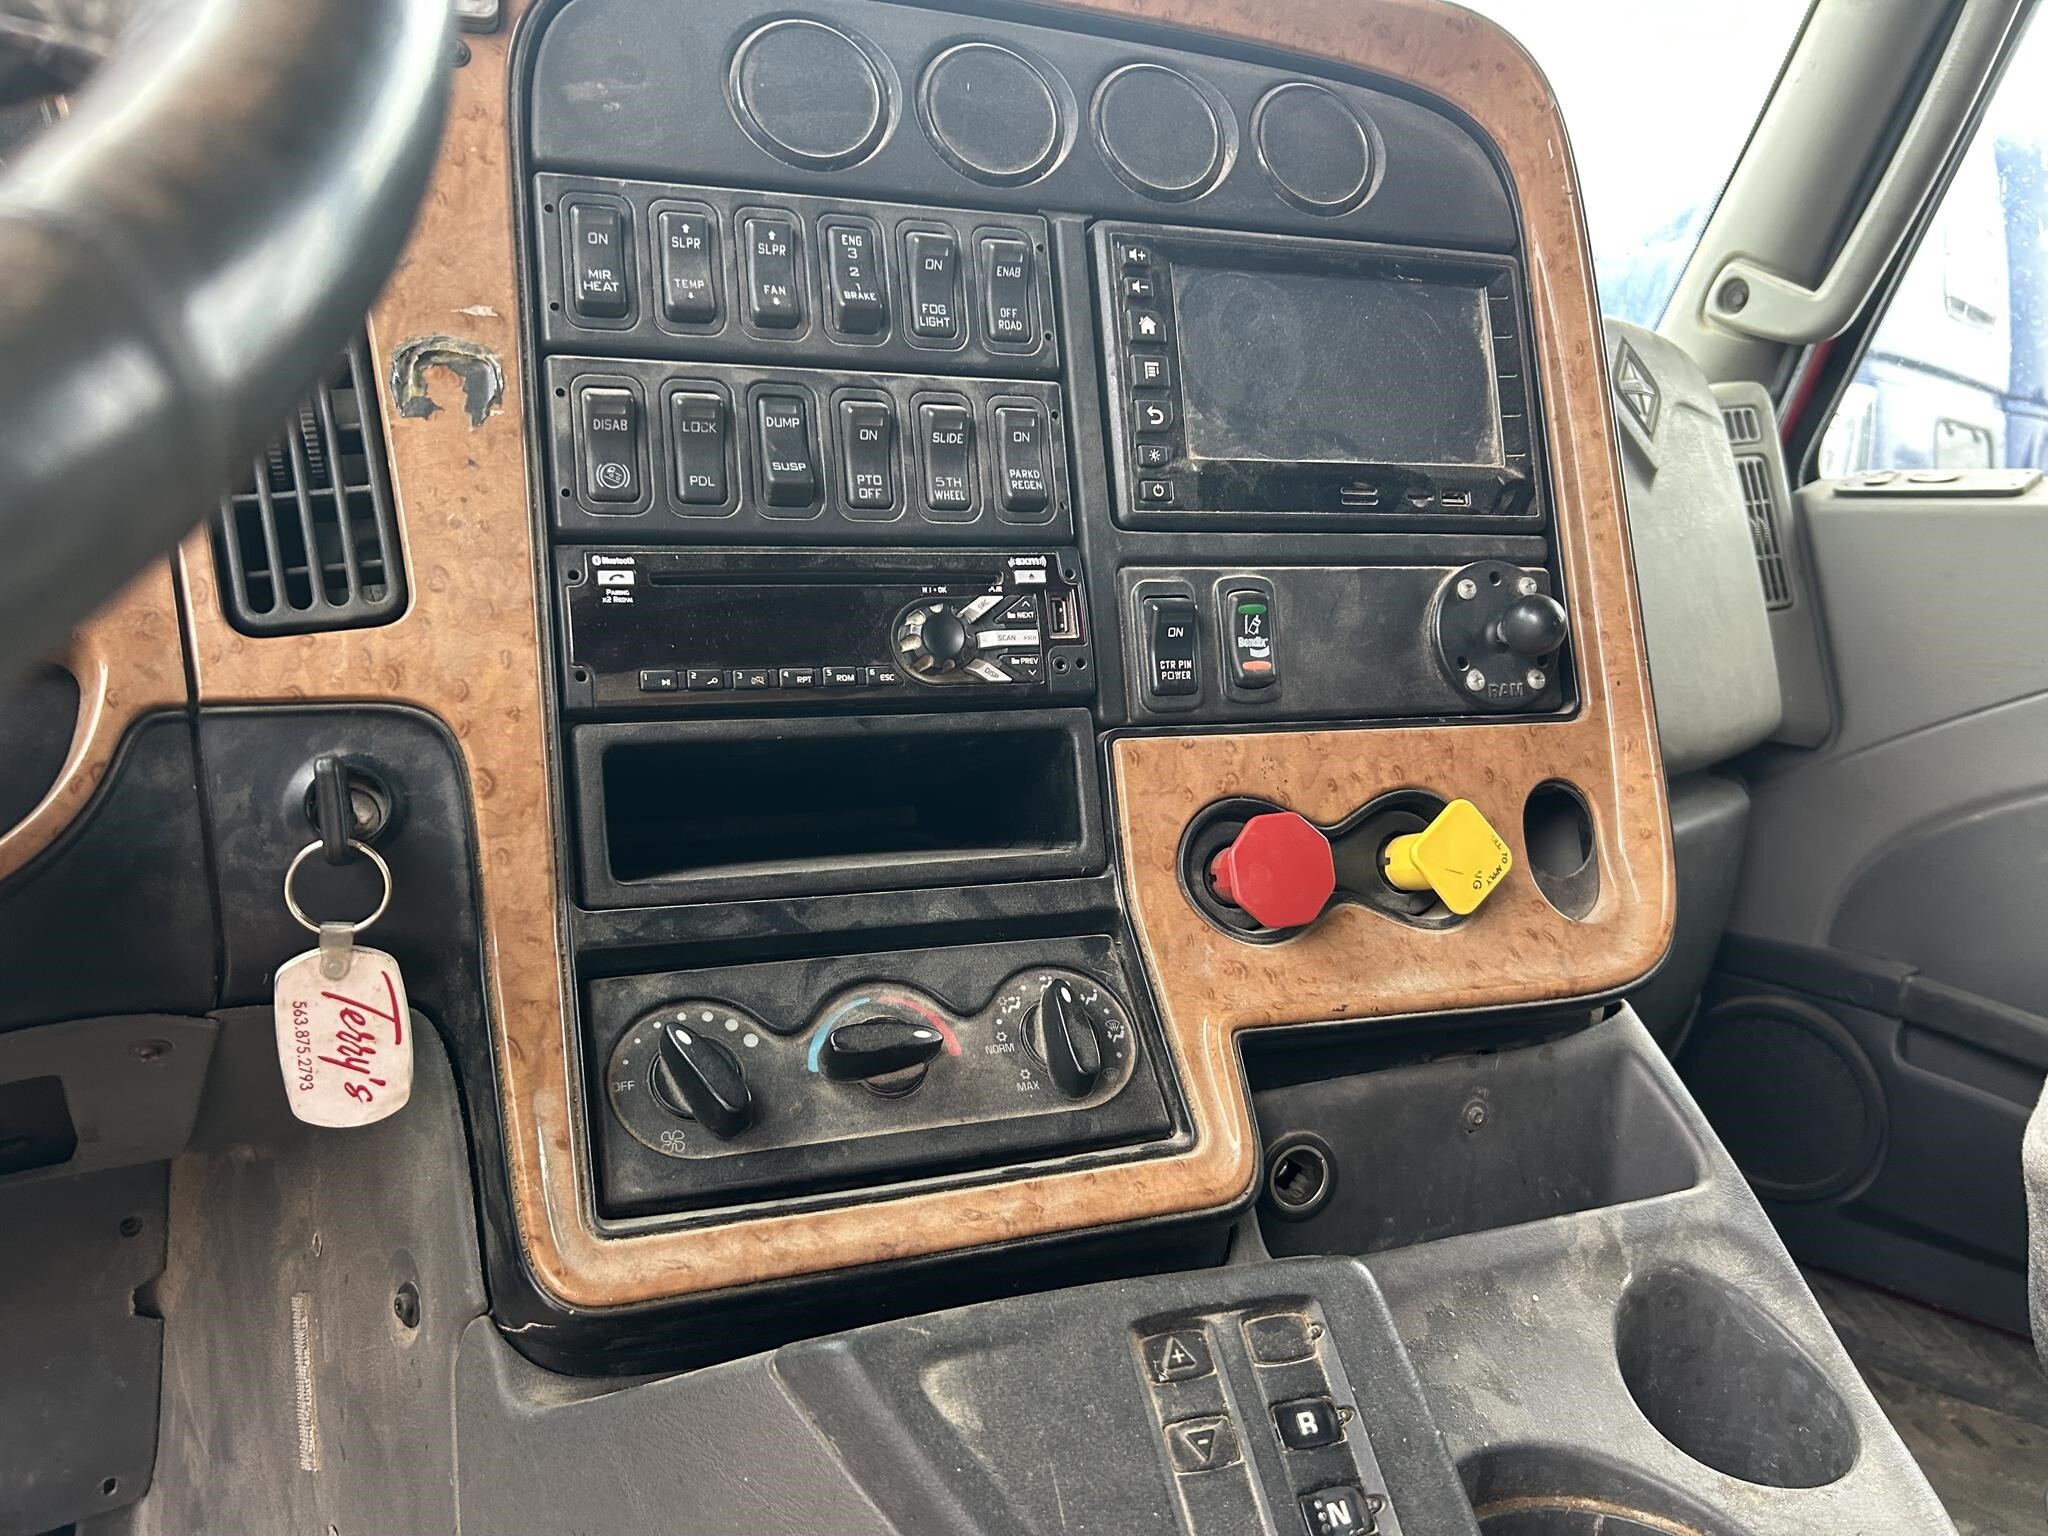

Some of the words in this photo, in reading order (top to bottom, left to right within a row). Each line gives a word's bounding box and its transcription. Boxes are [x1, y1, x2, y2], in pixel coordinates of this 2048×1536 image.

[588, 232, 608, 245] ON
[671, 237, 700, 249] SLPR
[841, 235, 862, 246] ENG
[758, 243, 786, 256] SLPR
[848, 248, 857, 258] 3
[925, 259, 942, 271] ON
[588, 269, 611, 280] MIR
[849, 267, 860, 277] 2
[996, 267, 1021, 278] ENAB
[583, 281, 619, 292] HEAT
[674, 279, 704, 290] TEMP
[763, 285, 786, 296] FAN
[843, 291, 877, 301] BRAKE
[922, 304, 946, 314] FOG
[1000, 308, 1017, 318] OFF
[919, 316, 950, 328] LIGHT
[998, 320, 1022, 331] ROAD
[593, 419, 628, 431] DISAB
[682, 421, 717, 433] LOCK
[766, 417, 800, 428] DUMP
[860, 429, 878, 441] ON
[932, 432, 964, 444] SLIDE
[1013, 432, 1030, 443] ON
[772, 462, 806, 471] SUSP
[1009, 469, 1040, 479] PARKD
[690, 475, 715, 487] PDL
[857, 475, 882, 486] PTO
[935, 477, 962, 487] 5TH
[1012, 480, 1043, 490] REGEN
[859, 488, 882, 499] OFF
[935, 490, 965, 501] WHEEL
[1168, 627, 1183, 637] ON
[1160, 660, 1175, 669] CTR
[1178, 661, 1192, 669] PIN
[984, 667, 999, 678] DISP
[1162, 671, 1191, 680] POWER
[1488, 682, 1524, 698] RAM
[1502, 853, 1508, 863] TO
[1487, 865, 1502, 885] APPLY
[317, 970, 401, 1104] Terry's
[293, 1000, 314, 1091] 563.875.2793
[985, 1043, 1014, 1054] NORM
[1017, 1081, 1040, 1091] MAX
[1296, 1412, 1319, 1435] R
[1326, 1500, 1351, 1527] N
